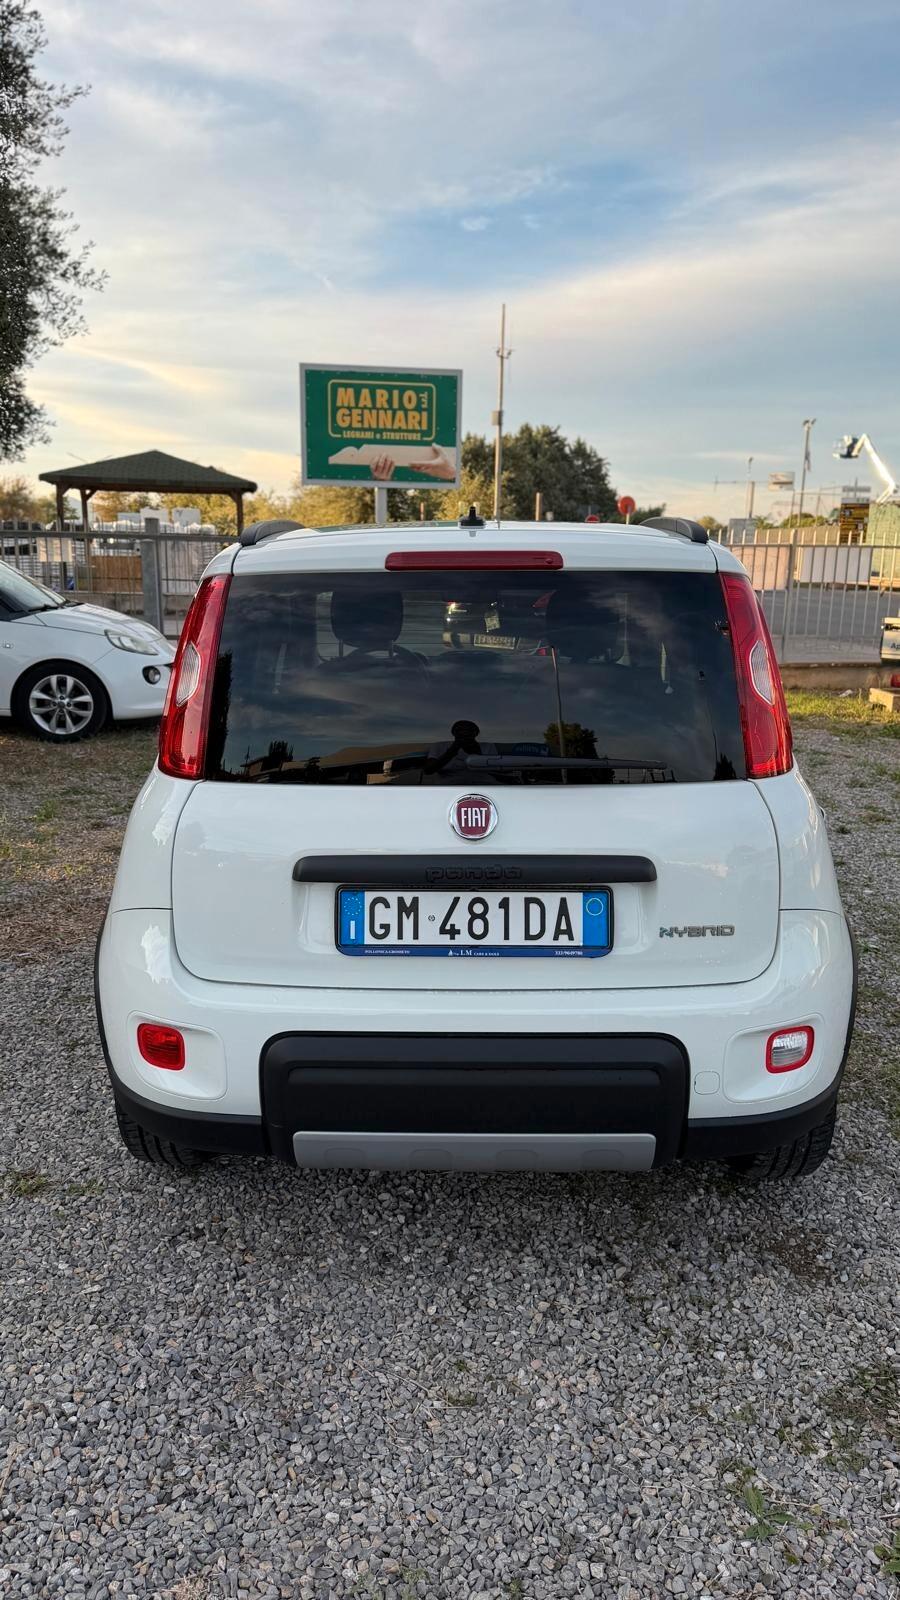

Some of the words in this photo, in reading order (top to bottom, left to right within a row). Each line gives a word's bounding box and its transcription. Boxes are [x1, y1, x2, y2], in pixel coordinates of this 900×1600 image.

[336, 387, 417, 409] MARIO
[336, 408, 428, 430] GENNARI
[343, 431, 374, 439] LEGNAMI
[382, 432, 421, 440] STRUTTURE
[461, 807, 488, 827] FIAT
[369, 896, 419, 940] GM
[659, 925, 735, 938] HYBRID
